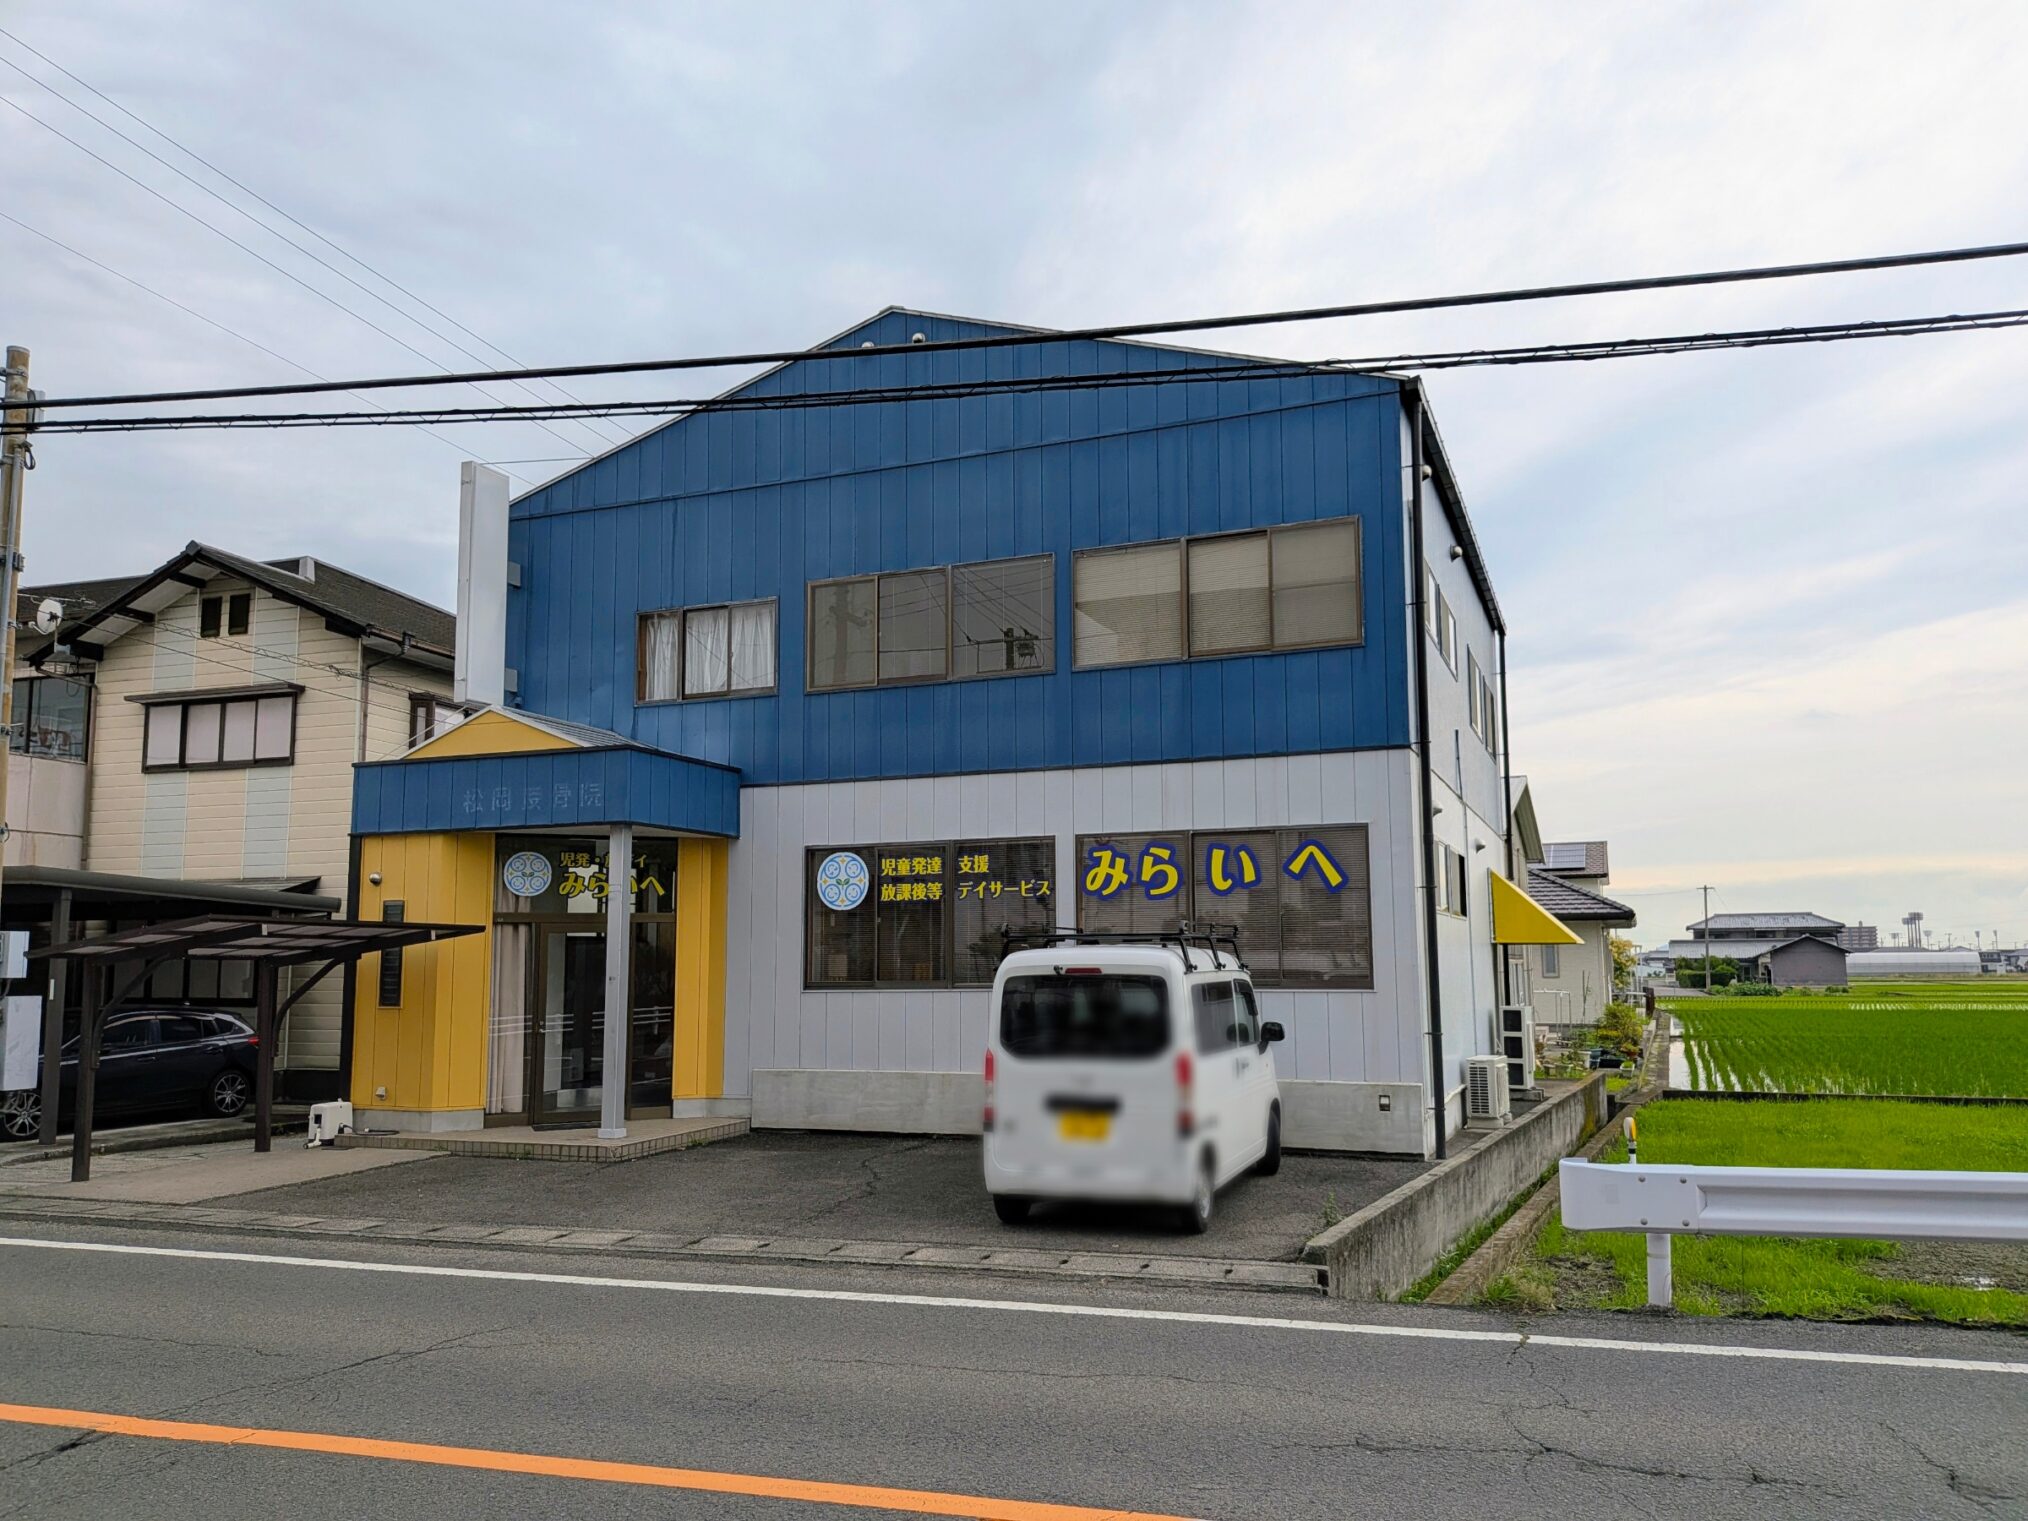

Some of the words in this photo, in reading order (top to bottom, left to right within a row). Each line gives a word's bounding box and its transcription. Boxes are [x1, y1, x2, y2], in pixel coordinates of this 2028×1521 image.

[881, 857, 943, 876] 児童発達
[958, 855, 989, 874] 支援
[1083, 840, 1348, 899] みらいへ
[881, 882, 943, 901] 放課後等
[958, 880, 1051, 899] デイサービス
